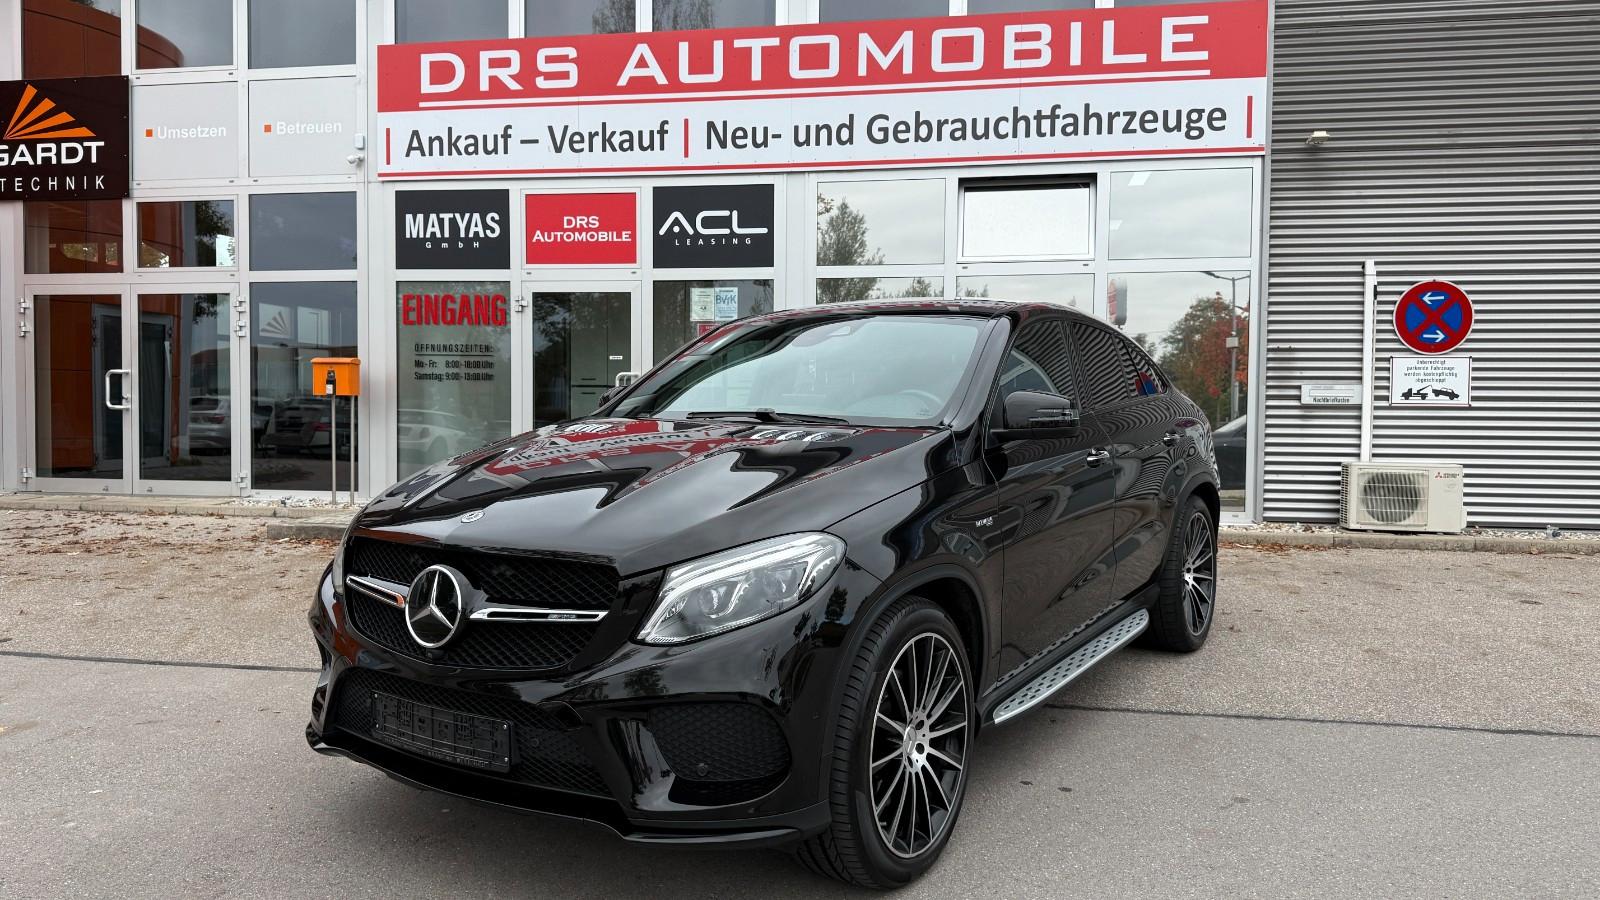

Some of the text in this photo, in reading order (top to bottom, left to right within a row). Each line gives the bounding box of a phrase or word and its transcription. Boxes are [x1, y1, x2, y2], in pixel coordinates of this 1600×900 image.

[419, 15, 1210, 95] DRS AUTOMOBILE
[157, 125, 227, 140] Umsetzen
[276, 120, 343, 136] Betreuen
[404, 124, 513, 158] Ankauf
[547, 120, 669, 154] Verkauf
[706, 119, 782, 150] Neu-
[793, 113, 855, 148] und
[866, 102, 1227, 145] Gebrauchtfahrzeuge
[405, 212, 501, 239] MATYAS
[563, 215, 600, 229] DRS
[659, 209, 769, 236] ACL
[532, 230, 632, 243] AUTOMOBILE
[675, 237, 751, 246] LEASING
[401, 292, 508, 327] EINGANG
